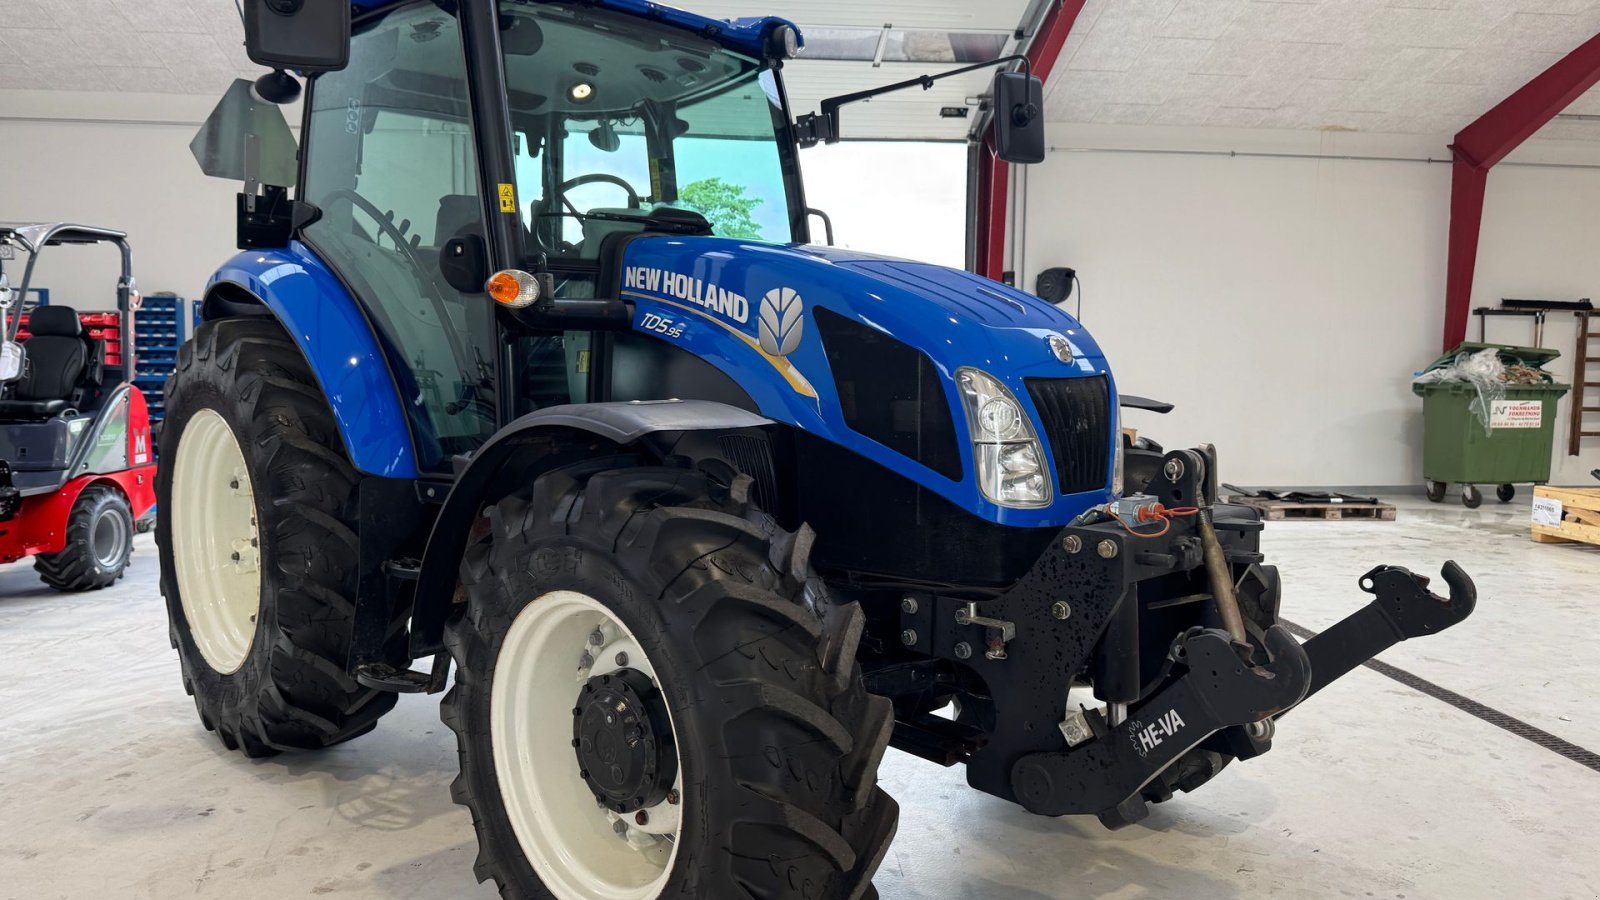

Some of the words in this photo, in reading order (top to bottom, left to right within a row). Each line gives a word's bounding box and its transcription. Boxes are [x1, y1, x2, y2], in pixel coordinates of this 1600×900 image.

[625, 266, 661, 292] NEW
[662, 270, 749, 324] HOLLAND
[1138, 709, 1186, 753] HE-VA
